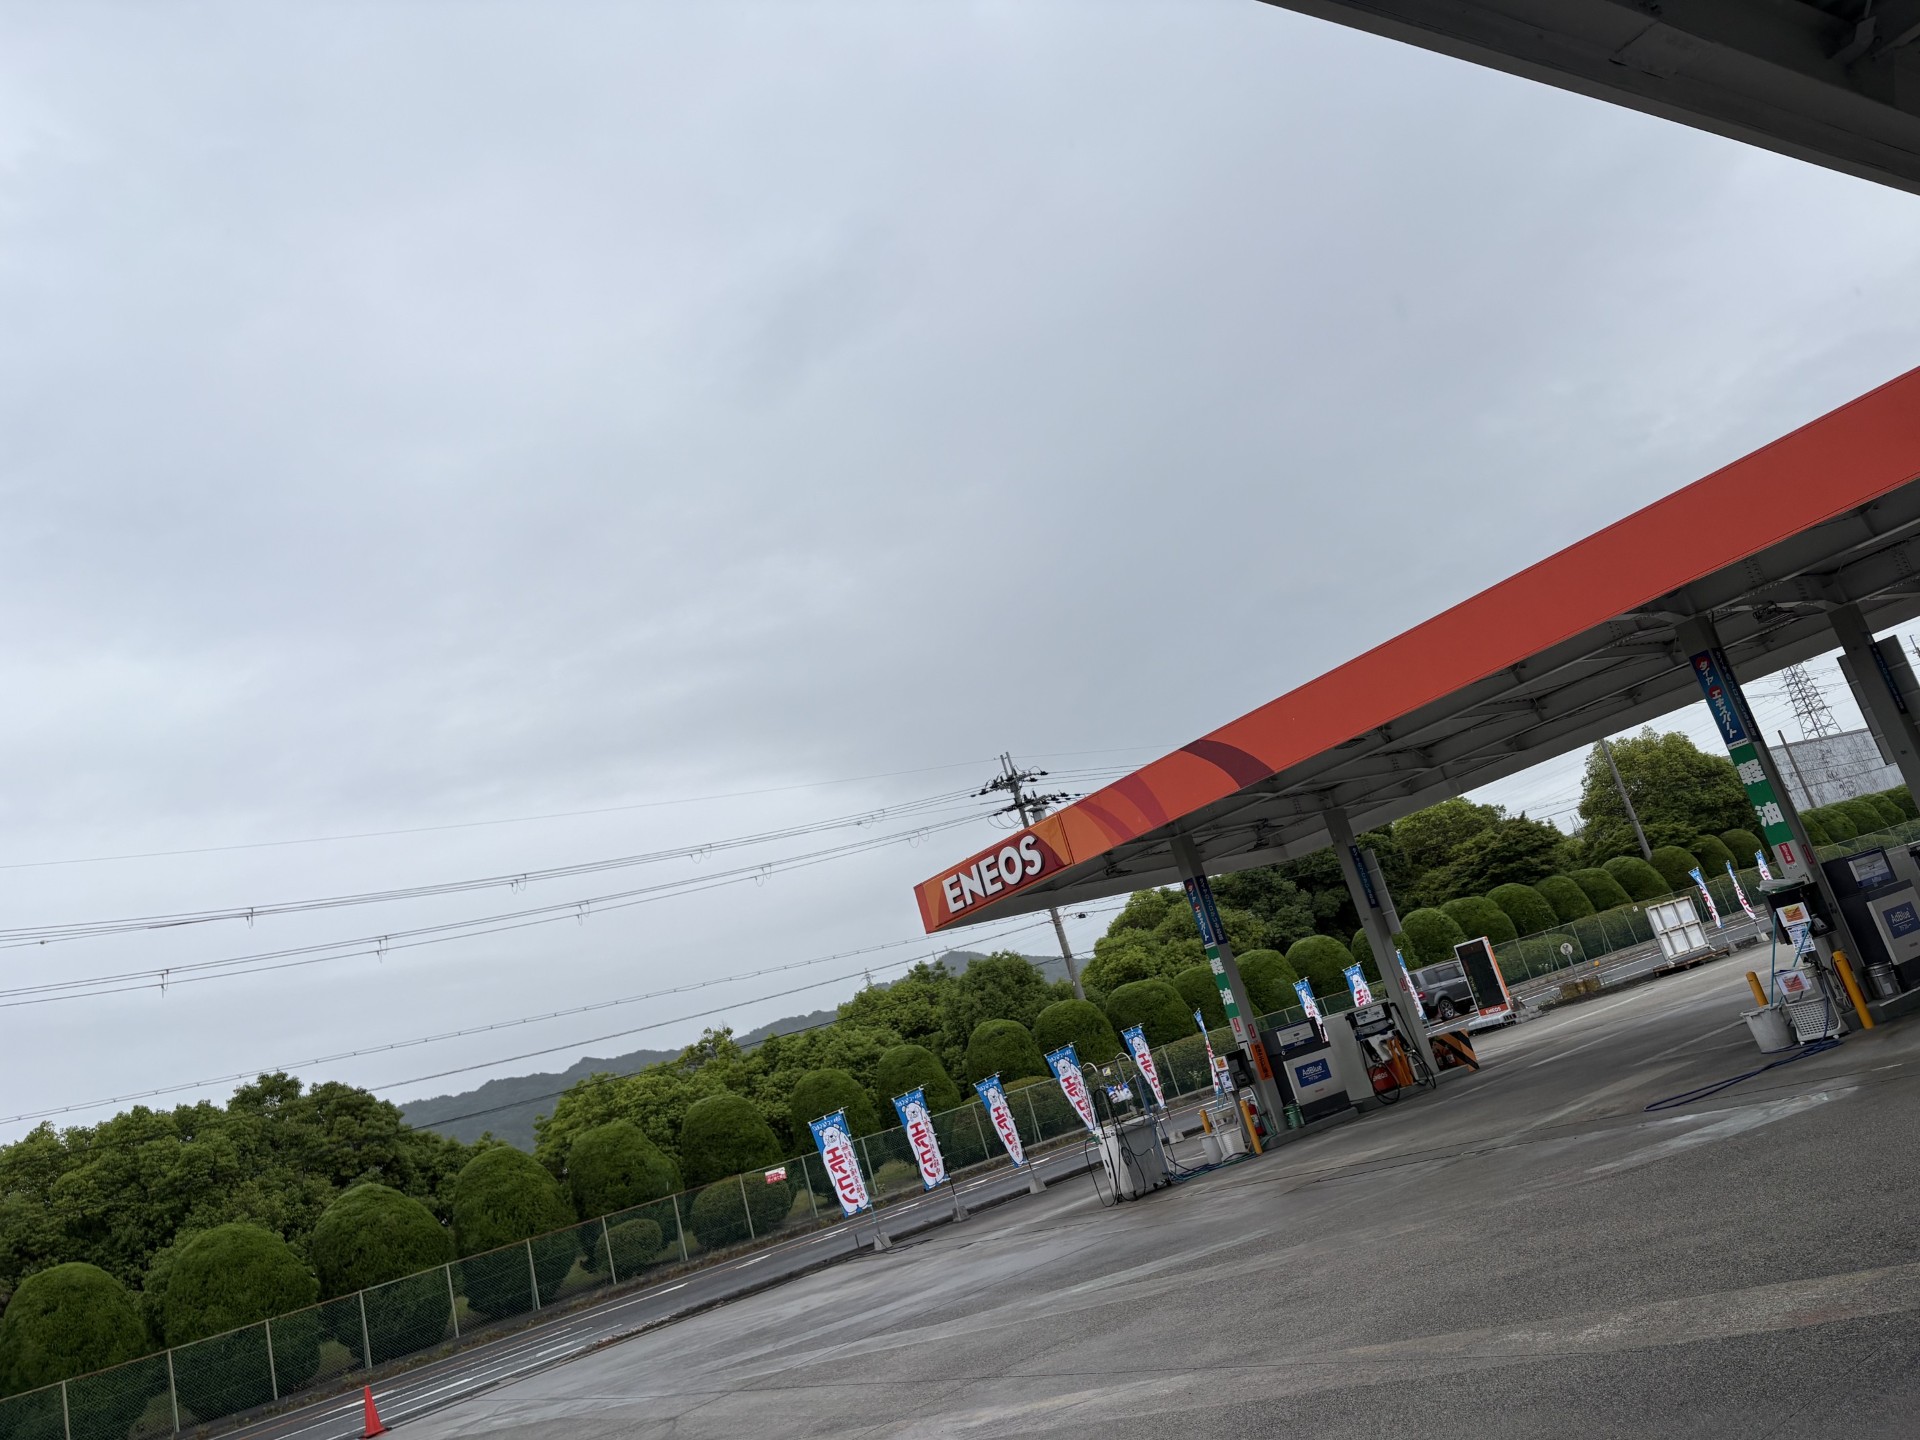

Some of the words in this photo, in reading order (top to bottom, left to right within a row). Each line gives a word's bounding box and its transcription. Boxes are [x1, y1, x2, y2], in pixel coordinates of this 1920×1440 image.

[1699, 661, 1714, 686] タイヤ
[1711, 688, 1737, 738] エキスパート
[1736, 758, 1785, 827] 軽油
[942, 836, 1043, 914] ENEOS
[1890, 909, 1911, 924] AdBlue
[1210, 957, 1235, 1005] 軽油
[1302, 1063, 1323, 1076] AdBlue
